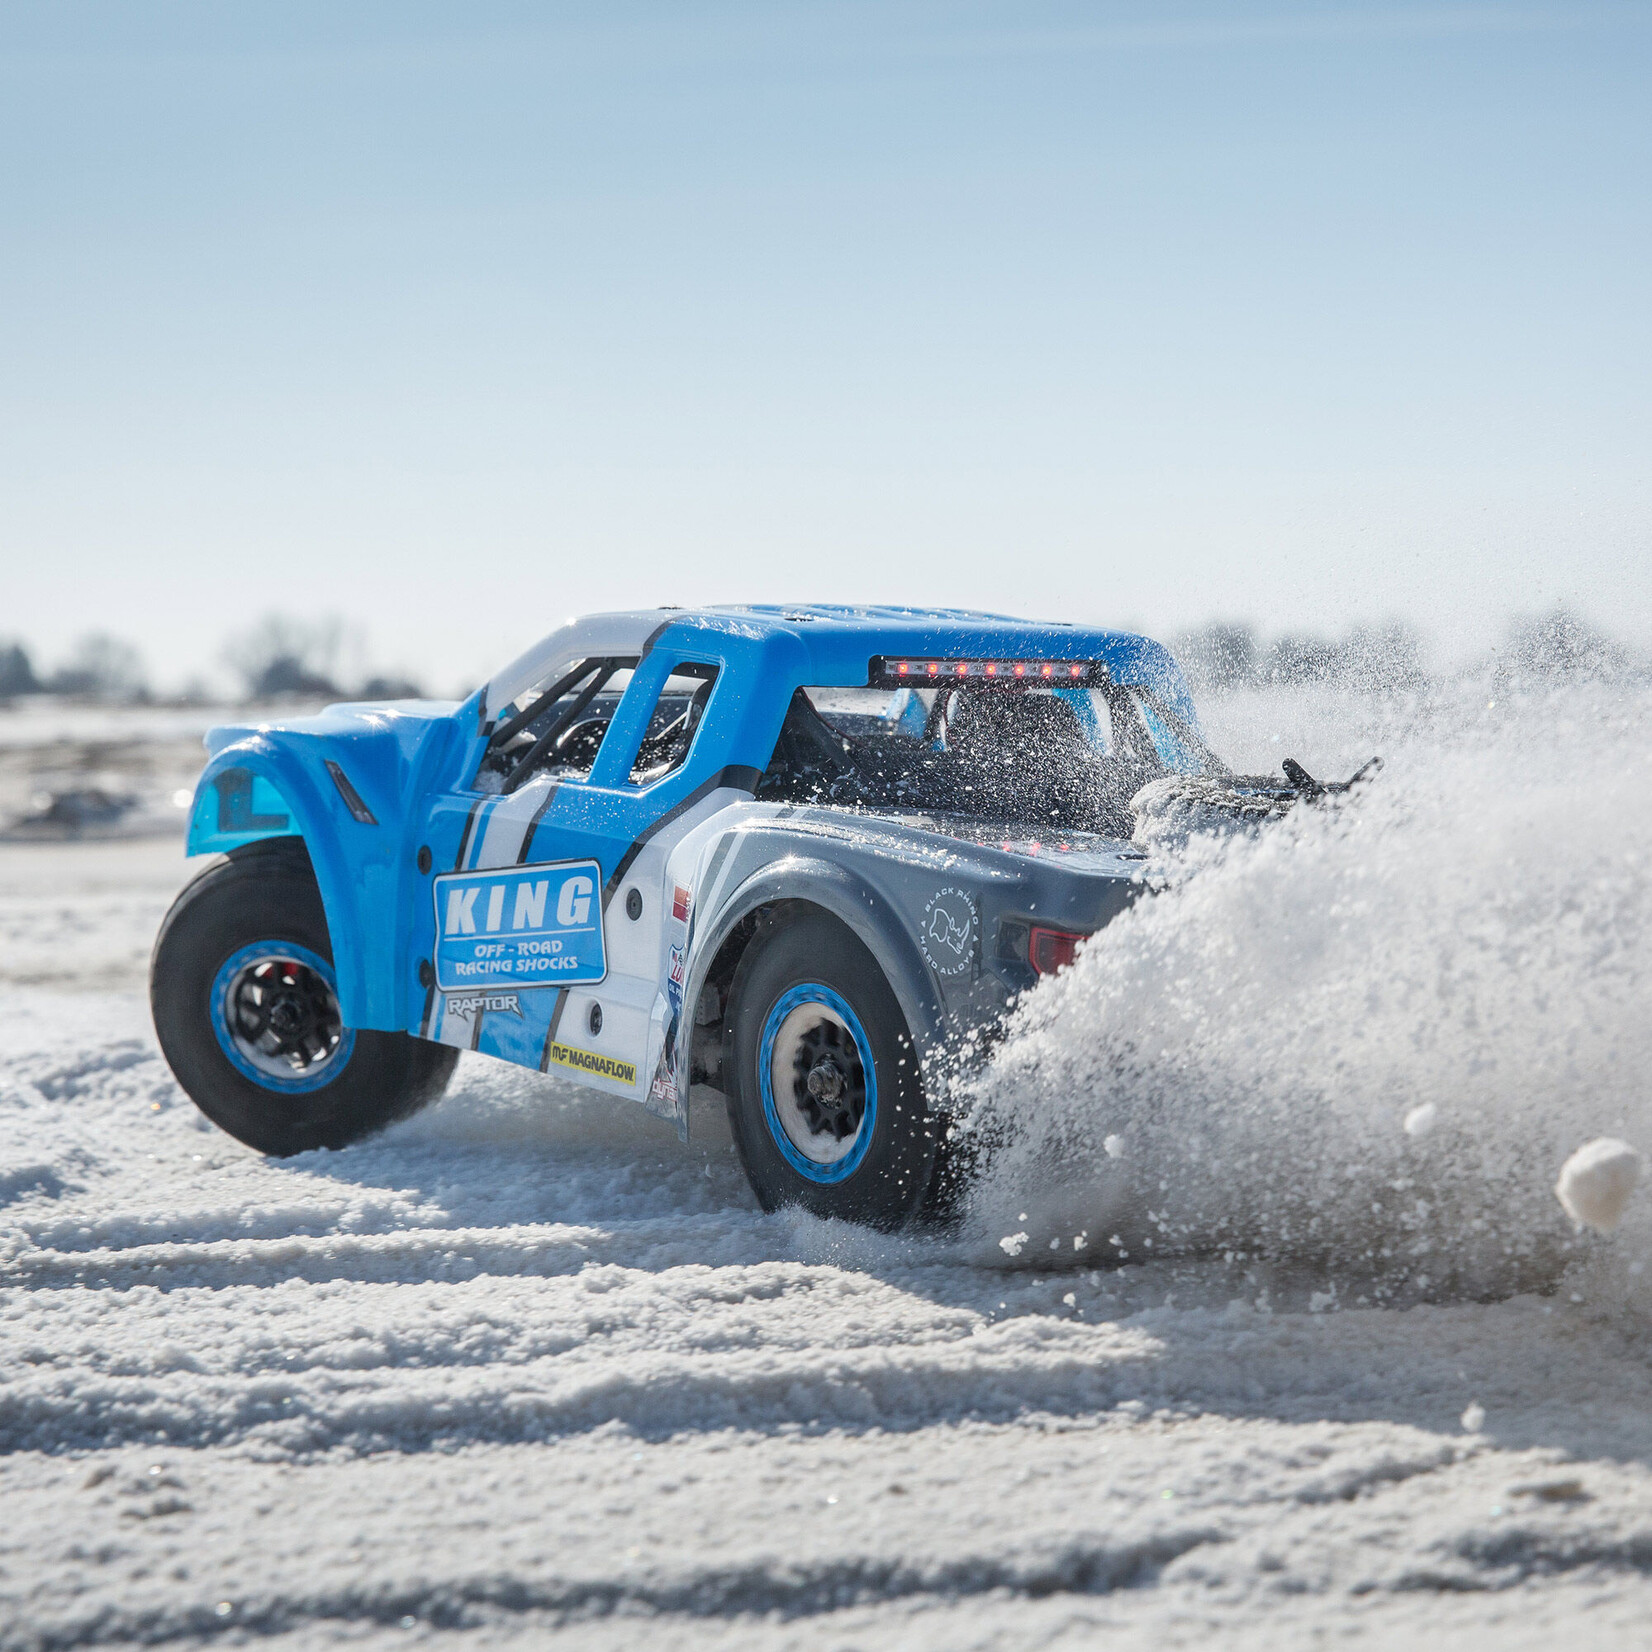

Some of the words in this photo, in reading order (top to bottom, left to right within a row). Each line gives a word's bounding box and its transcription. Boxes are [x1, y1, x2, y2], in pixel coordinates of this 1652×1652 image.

[445, 876, 593, 935] KING
[925, 887, 954, 913] BLACK
[957, 889, 979, 925] RHINO
[455, 960, 512, 976] RACING
[516, 956, 578, 972] SHOCKS
[920, 935, 938, 970] HARD
[940, 950, 975, 975] ALLOYS
[448, 994, 523, 1021] RAPTOR
[569, 1050, 634, 1082] MAGNAFLOW
